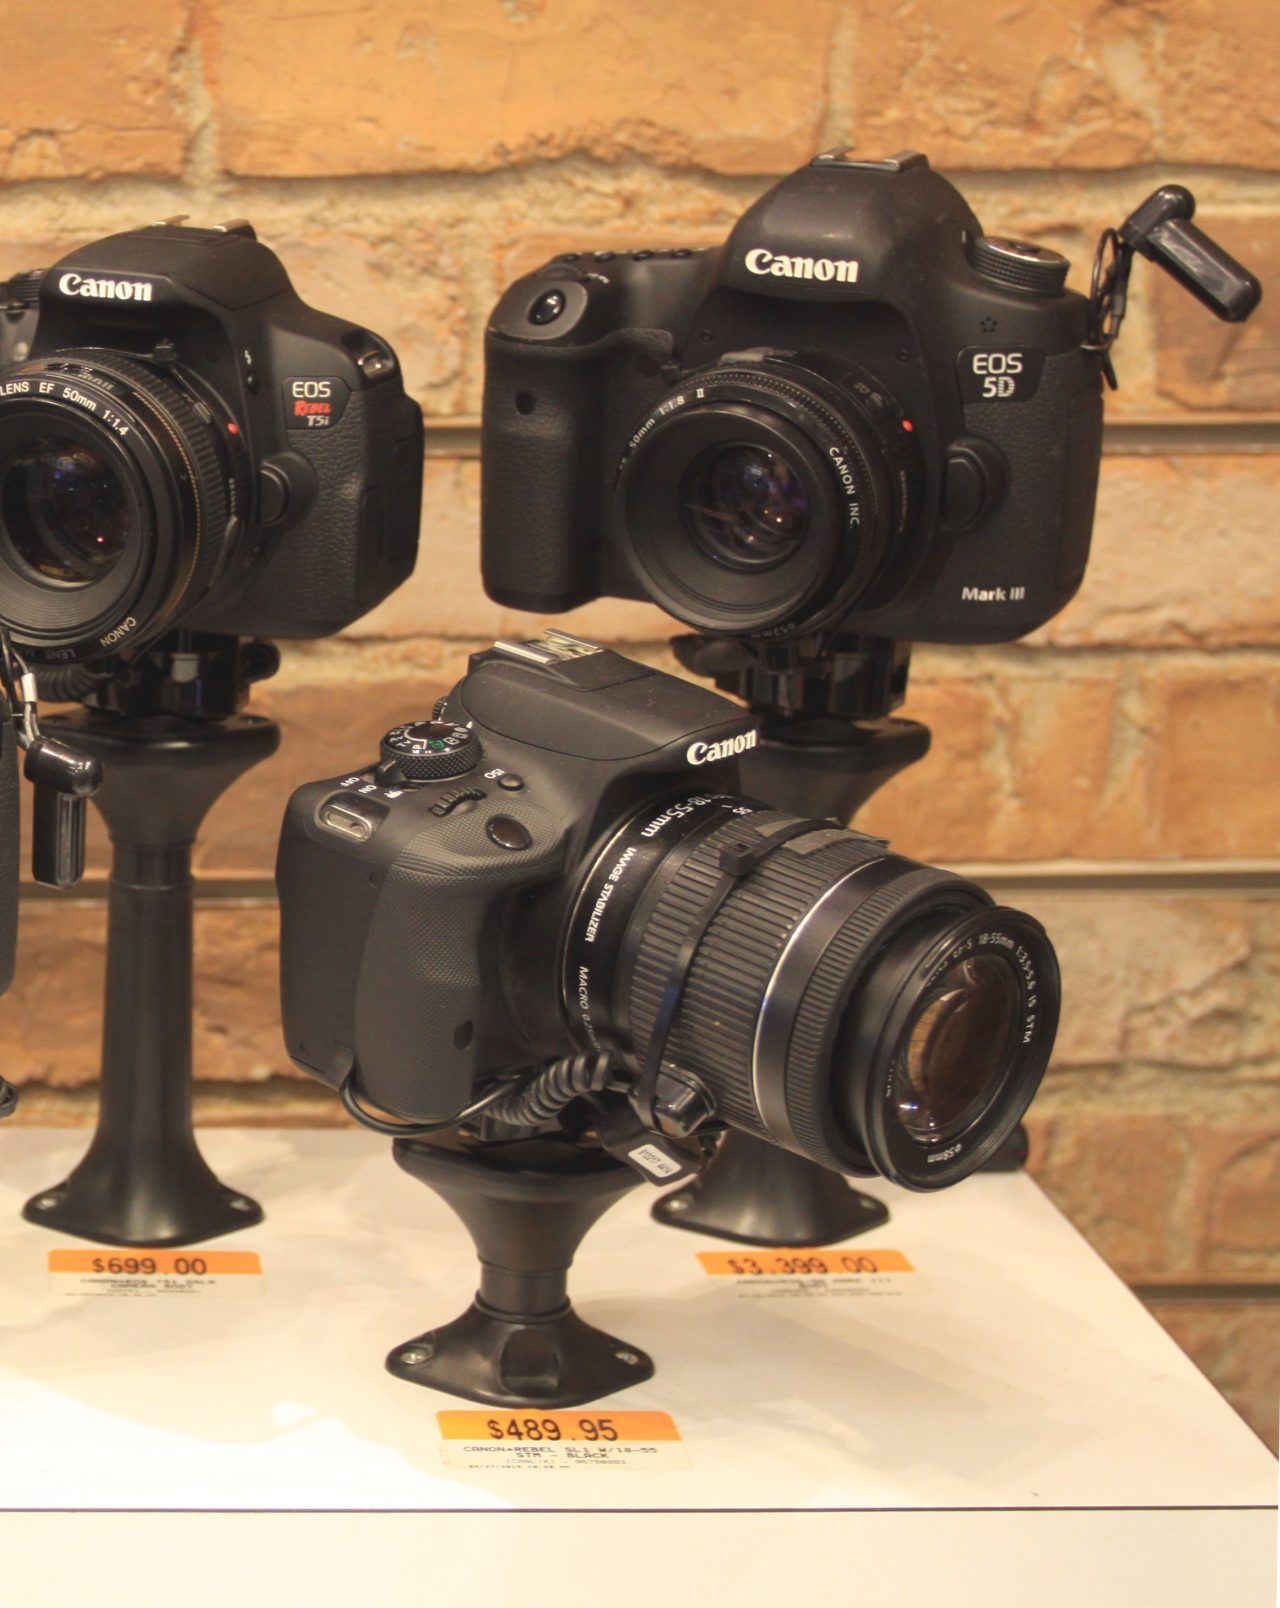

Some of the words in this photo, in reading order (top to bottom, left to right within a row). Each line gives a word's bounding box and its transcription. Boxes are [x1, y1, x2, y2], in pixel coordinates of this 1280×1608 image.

[745, 248, 859, 283] Canon
[58, 273, 152, 301] Canon
[972, 353, 1023, 375] EOS
[292, 381, 331, 398] EOS
[982, 376, 1016, 398] 5D
[0, 381, 30, 397] LENS
[38, 382, 56, 395] EF
[62, 386, 97, 412] 50mm
[102, 409, 130, 437] 1:1.4
[628, 418, 656, 448] 50mm
[659, 395, 686, 416] 1:1.8
[828, 446, 856, 495] CANON
[961, 586, 1007, 602] Mark
[1009, 586, 1026, 601] III
[99, 616, 137, 648] CANON
[686, 728, 757, 766] Canon
[357, 784, 378, 794] ON
[484, 768, 506, 780] ISO
[641, 795, 712, 838] 18-55mm
[608, 846, 637, 883] IMAGE
[584, 882, 614, 943] STABILIZER
[578, 966, 590, 1010] MACRO
[486, 1418, 619, 1442] $489.95
